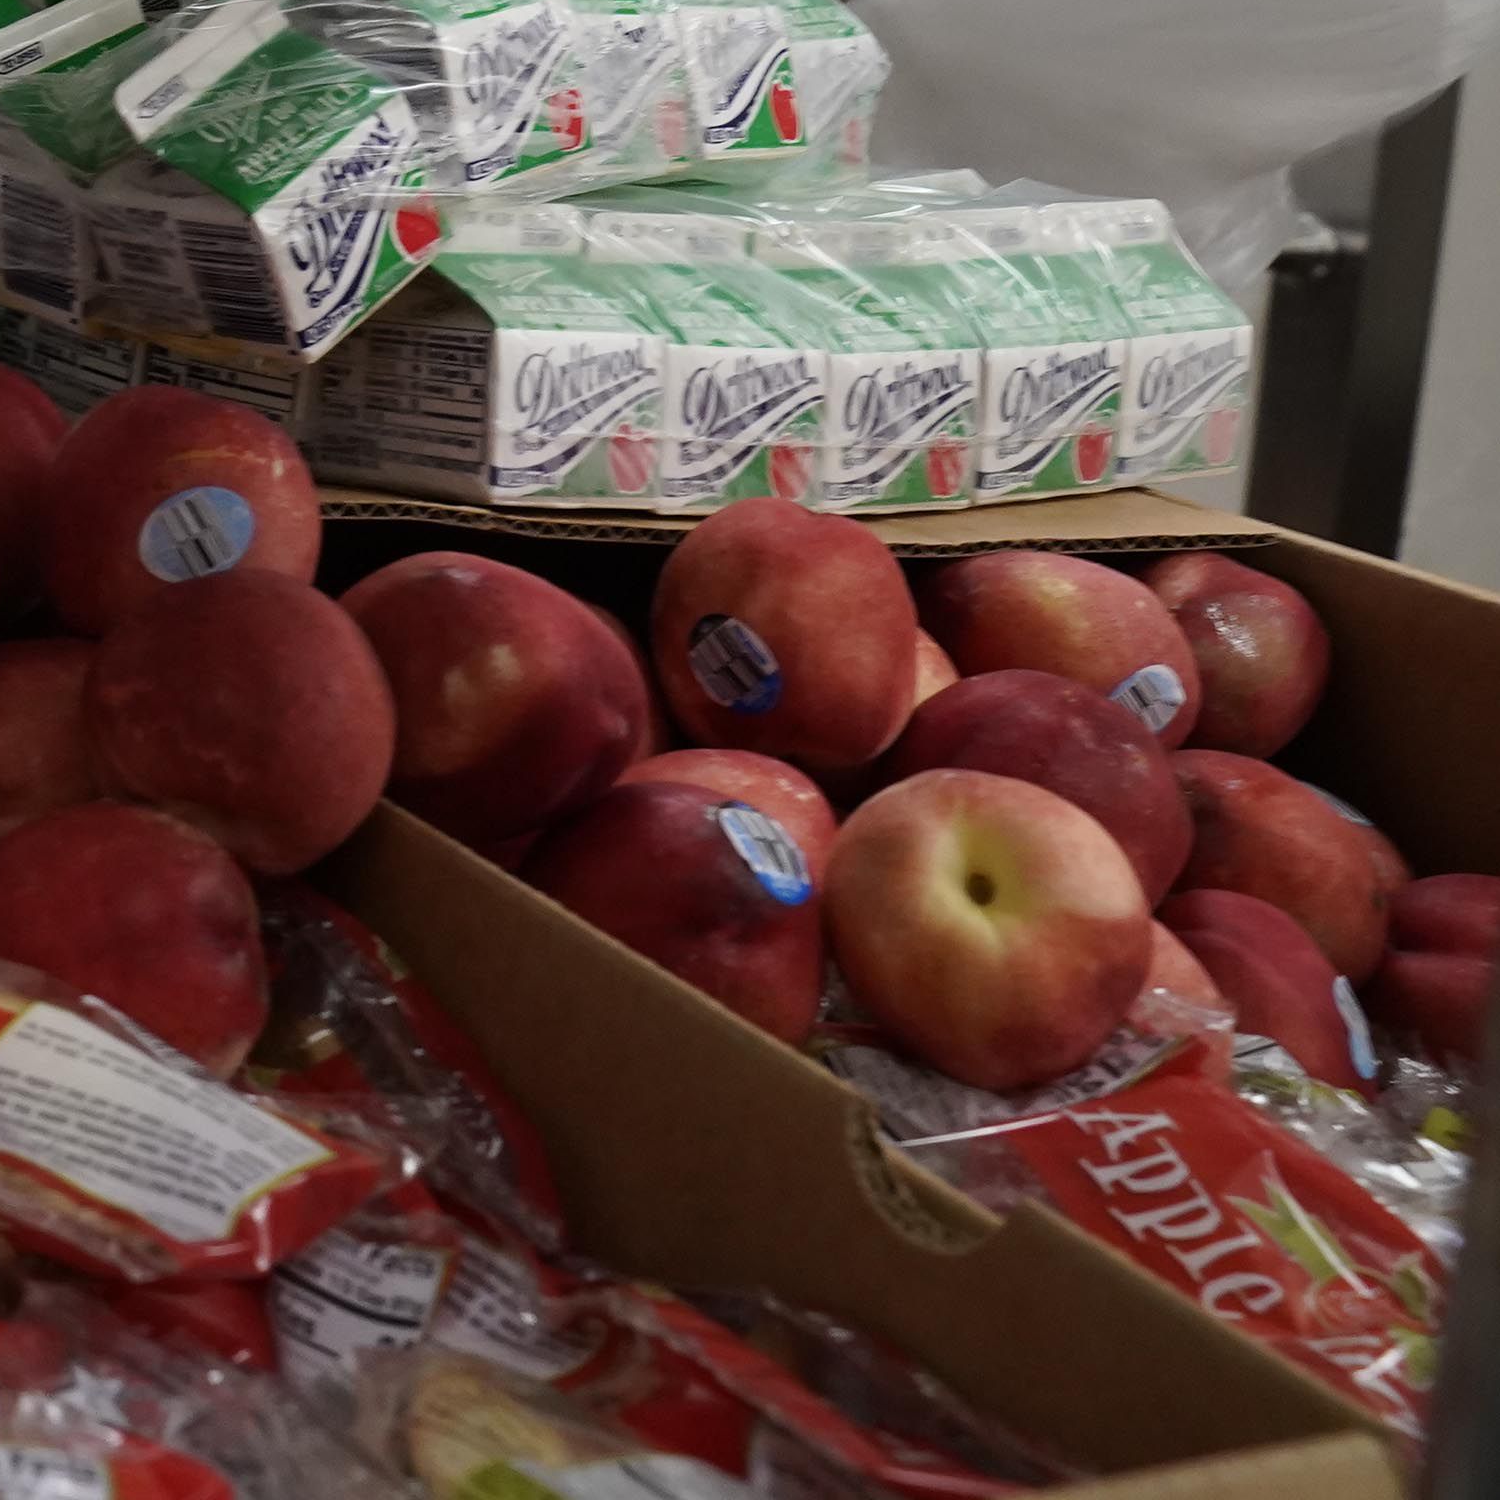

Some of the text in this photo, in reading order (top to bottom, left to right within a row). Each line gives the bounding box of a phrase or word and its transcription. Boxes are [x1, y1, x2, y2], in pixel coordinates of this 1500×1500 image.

[515, 338, 646, 430] Driftwood
[682, 354, 808, 440] Driftwood
[843, 352, 965, 450] Driftwood
[998, 345, 1111, 440] Driftwood
[1062, 1107, 1285, 1323] Apple
